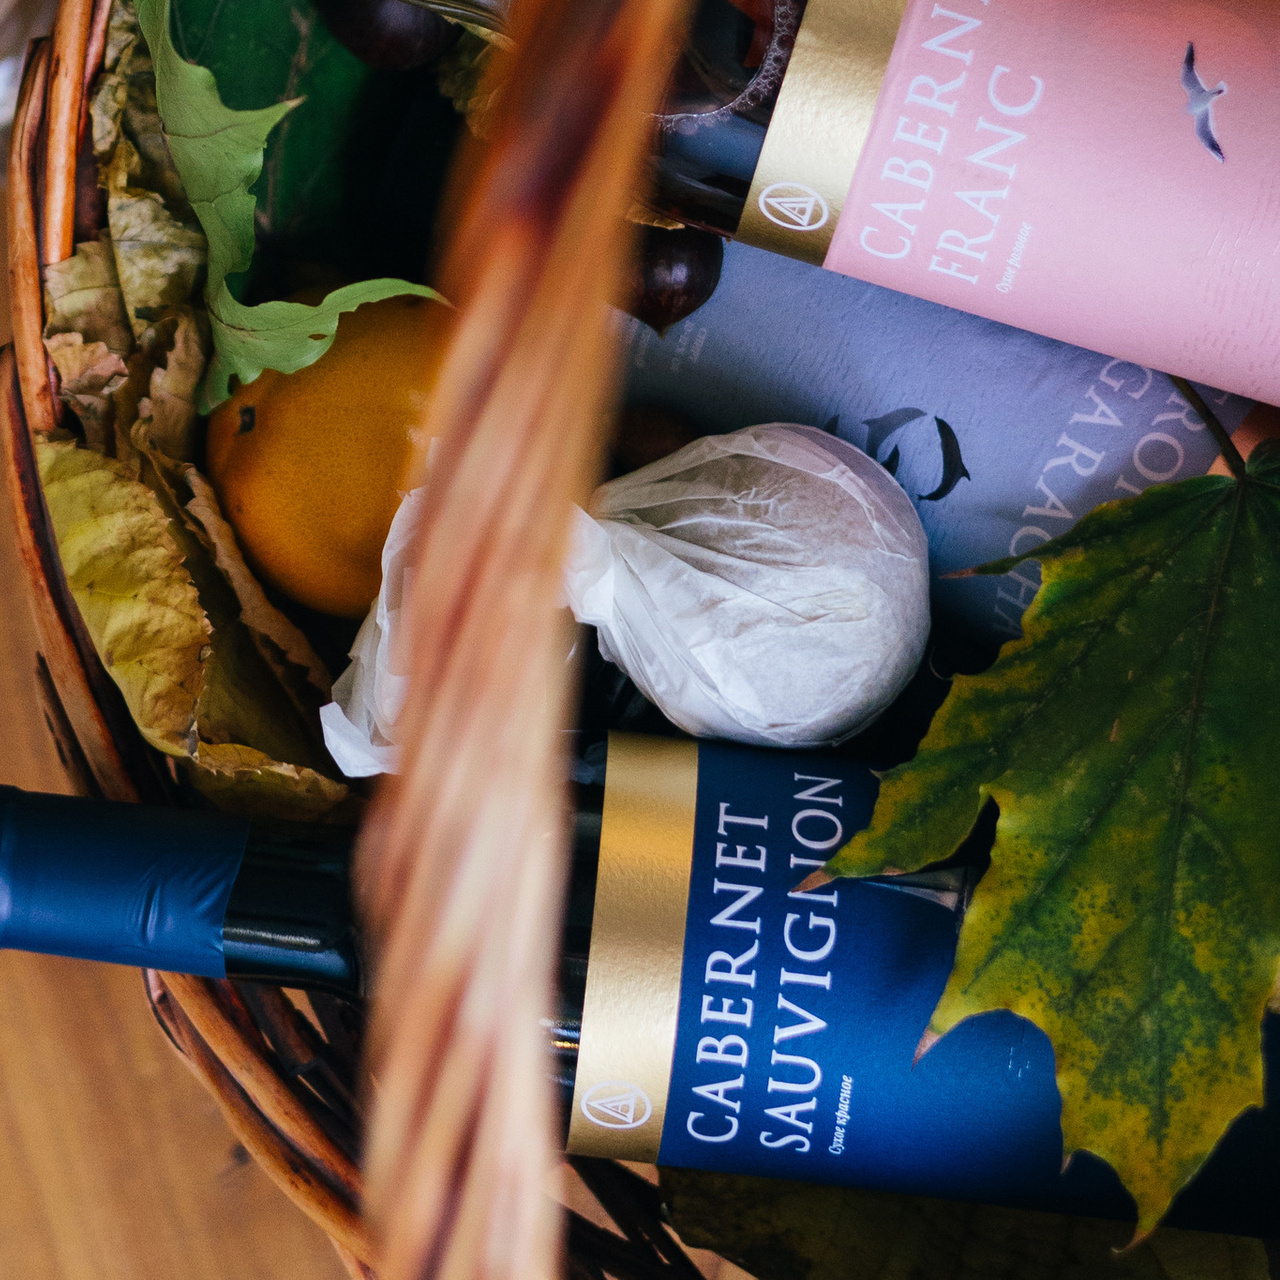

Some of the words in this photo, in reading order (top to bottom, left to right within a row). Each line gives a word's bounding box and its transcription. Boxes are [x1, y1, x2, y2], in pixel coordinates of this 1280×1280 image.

[928, 65, 1044, 285] FRANC
[995, 266, 1016, 293] Сухое
[1006, 220, 1032, 269] розовое
[686, 802, 769, 1144] CABERNET
[760, 772, 844, 1153] SAUVIGNON
[828, 1126, 846, 1155] Сухое
[835, 1074, 853, 1126] красное
